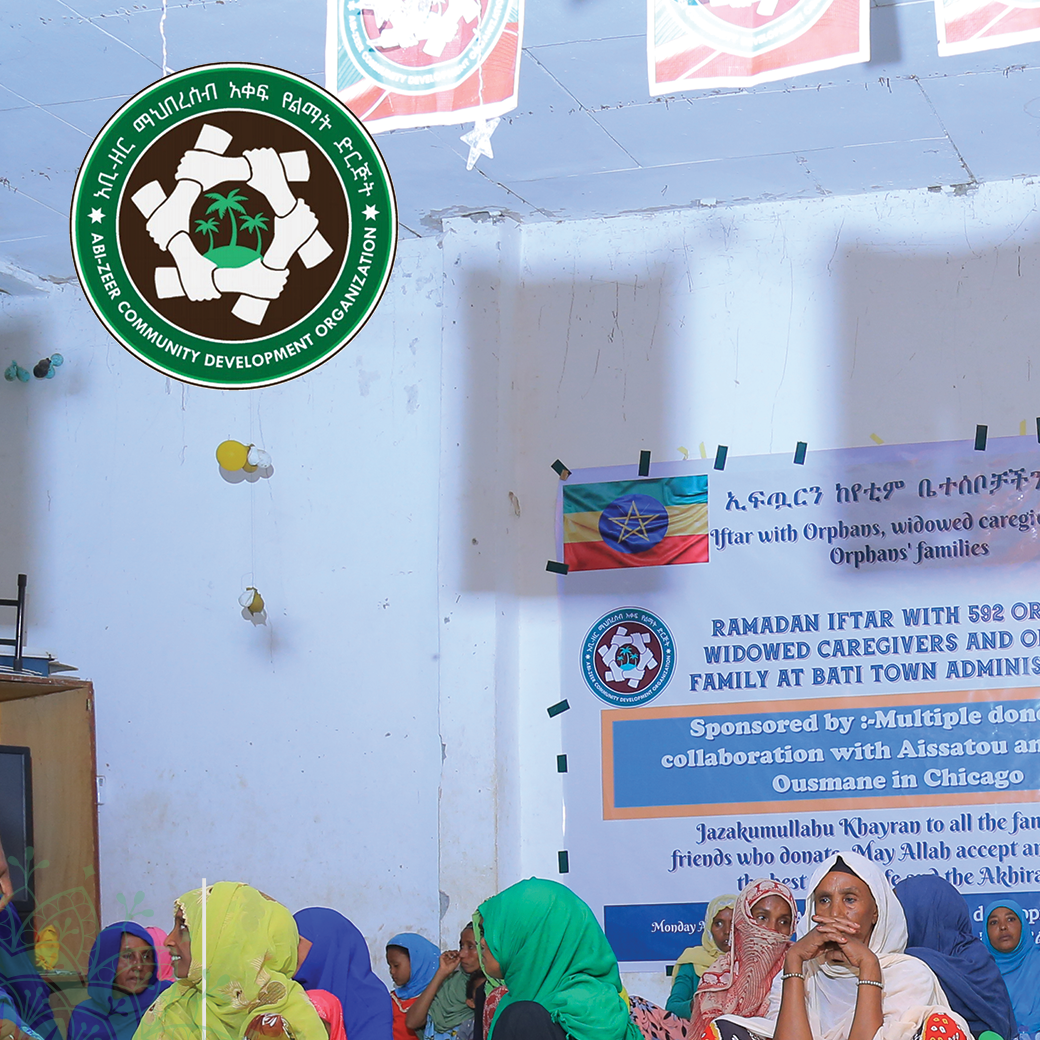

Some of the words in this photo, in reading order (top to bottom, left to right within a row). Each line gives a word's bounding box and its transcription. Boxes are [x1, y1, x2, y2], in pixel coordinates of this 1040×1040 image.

[835, 480, 905, 503] ከየቲም
[710, 527, 754, 550] Iftar
[758, 524, 798, 544] with
[803, 521, 885, 544] Orphans,
[891, 511, 973, 534] widowed
[830, 543, 911, 569] Orphans'
[913, 539, 990, 565] families
[711, 613, 820, 637] RAMADAN
[827, 609, 895, 631] IFTAR
[902, 605, 960, 627] WITH
[968, 603, 1005, 623] 592
[703, 641, 811, 664] WIDOWED
[817, 632, 959, 659] CAREGIVERS
[965, 630, 1014, 651] AND
[689, 669, 770, 692] FAMILY
[776, 668, 805, 688] AT
[811, 664, 863, 686] BATI
[870, 661, 937, 683] TOWN
[690, 714, 819, 741] Sponsored
[824, 712, 855, 734] by
[860, 706, 982, 730] :-Multiple
[661, 745, 825, 768] collaboration
[829, 741, 892, 761] with
[897, 737, 1008, 759] Aissatou
[772, 773, 887, 793] Ousmane
[892, 770, 918, 789] in
[923, 767, 1025, 789] Chicago
[696, 818, 836, 845] Jazakumullahu
[839, 815, 921, 839] Khayran
[926, 816, 944, 833] to
[949, 812, 972, 832] all
[977, 812, 1006, 831] the
[667, 848, 732, 873] friends
[736, 846, 775, 866] who
[780, 845, 840, 865] donat
[851, 839, 895, 866] May
[898, 841, 951, 862] Allah
[955, 839, 1018, 862] accept
[945, 866, 974, 887] the
[651, 919, 697, 934] Monday
